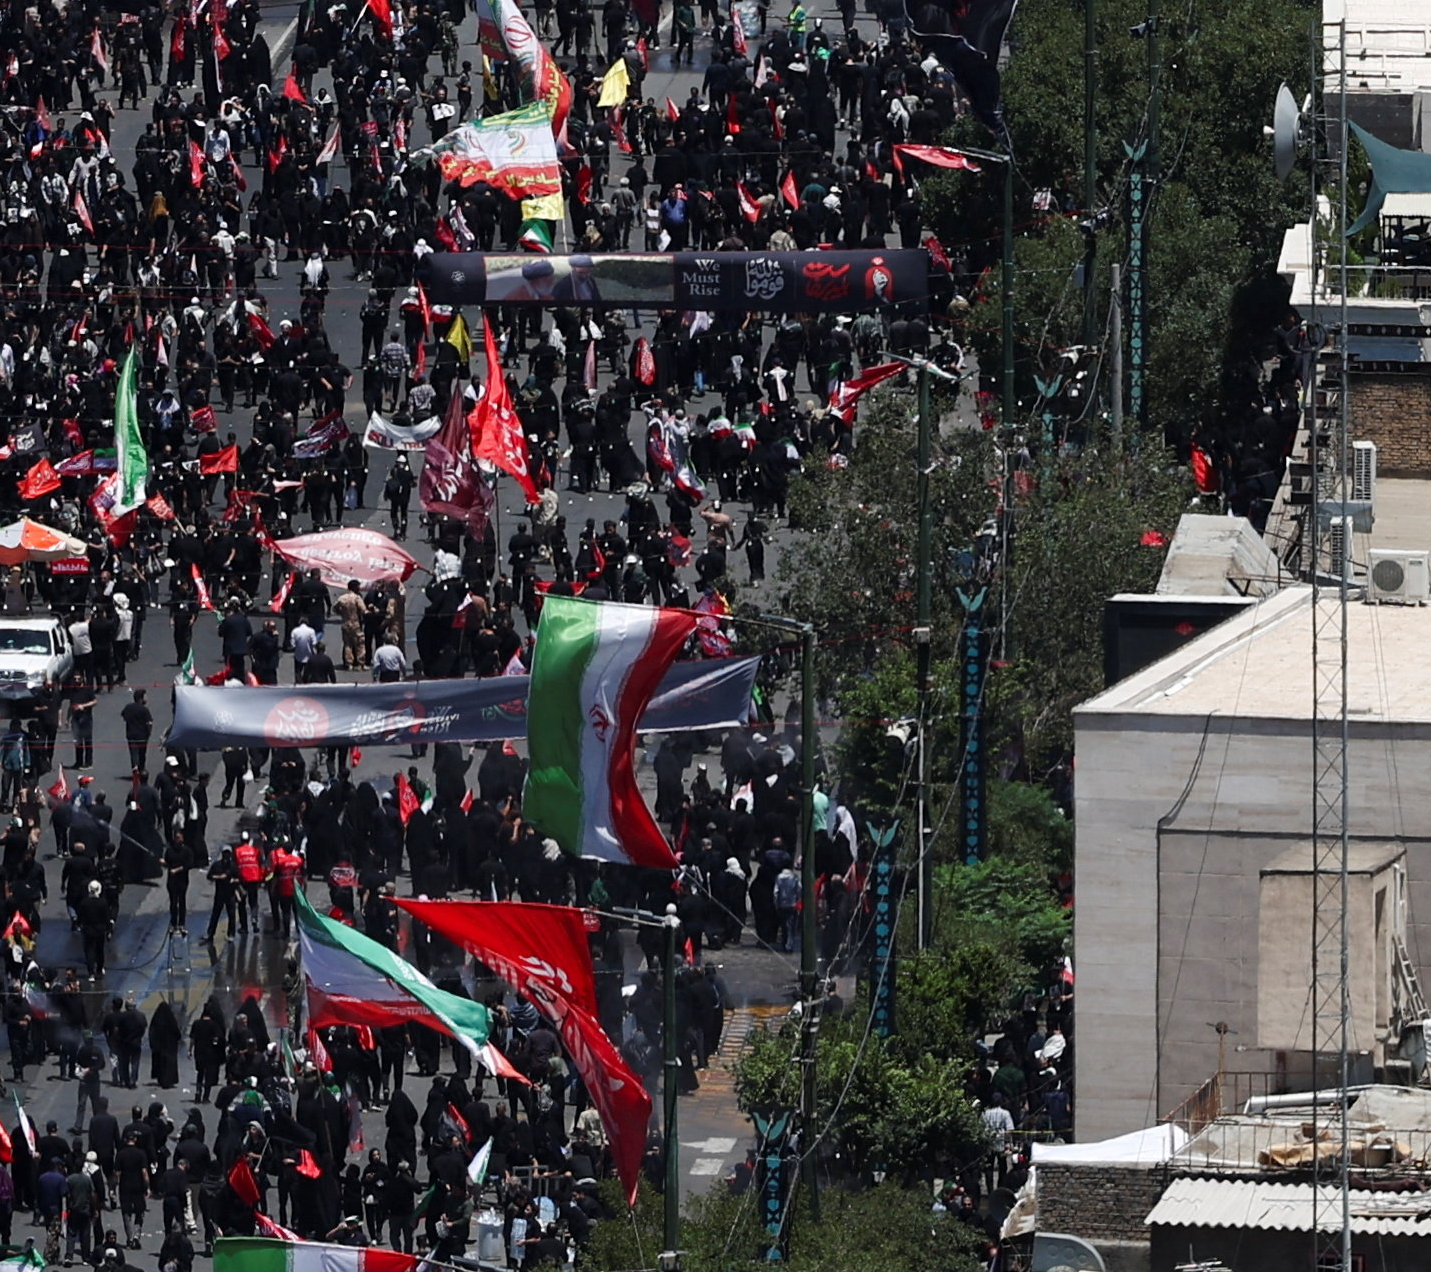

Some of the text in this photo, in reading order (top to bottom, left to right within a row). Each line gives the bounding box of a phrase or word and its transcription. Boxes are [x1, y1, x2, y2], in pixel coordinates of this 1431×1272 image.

[695, 259, 720, 271] We
[682, 272, 720, 284] Must
[689, 283, 720, 296] Rise
